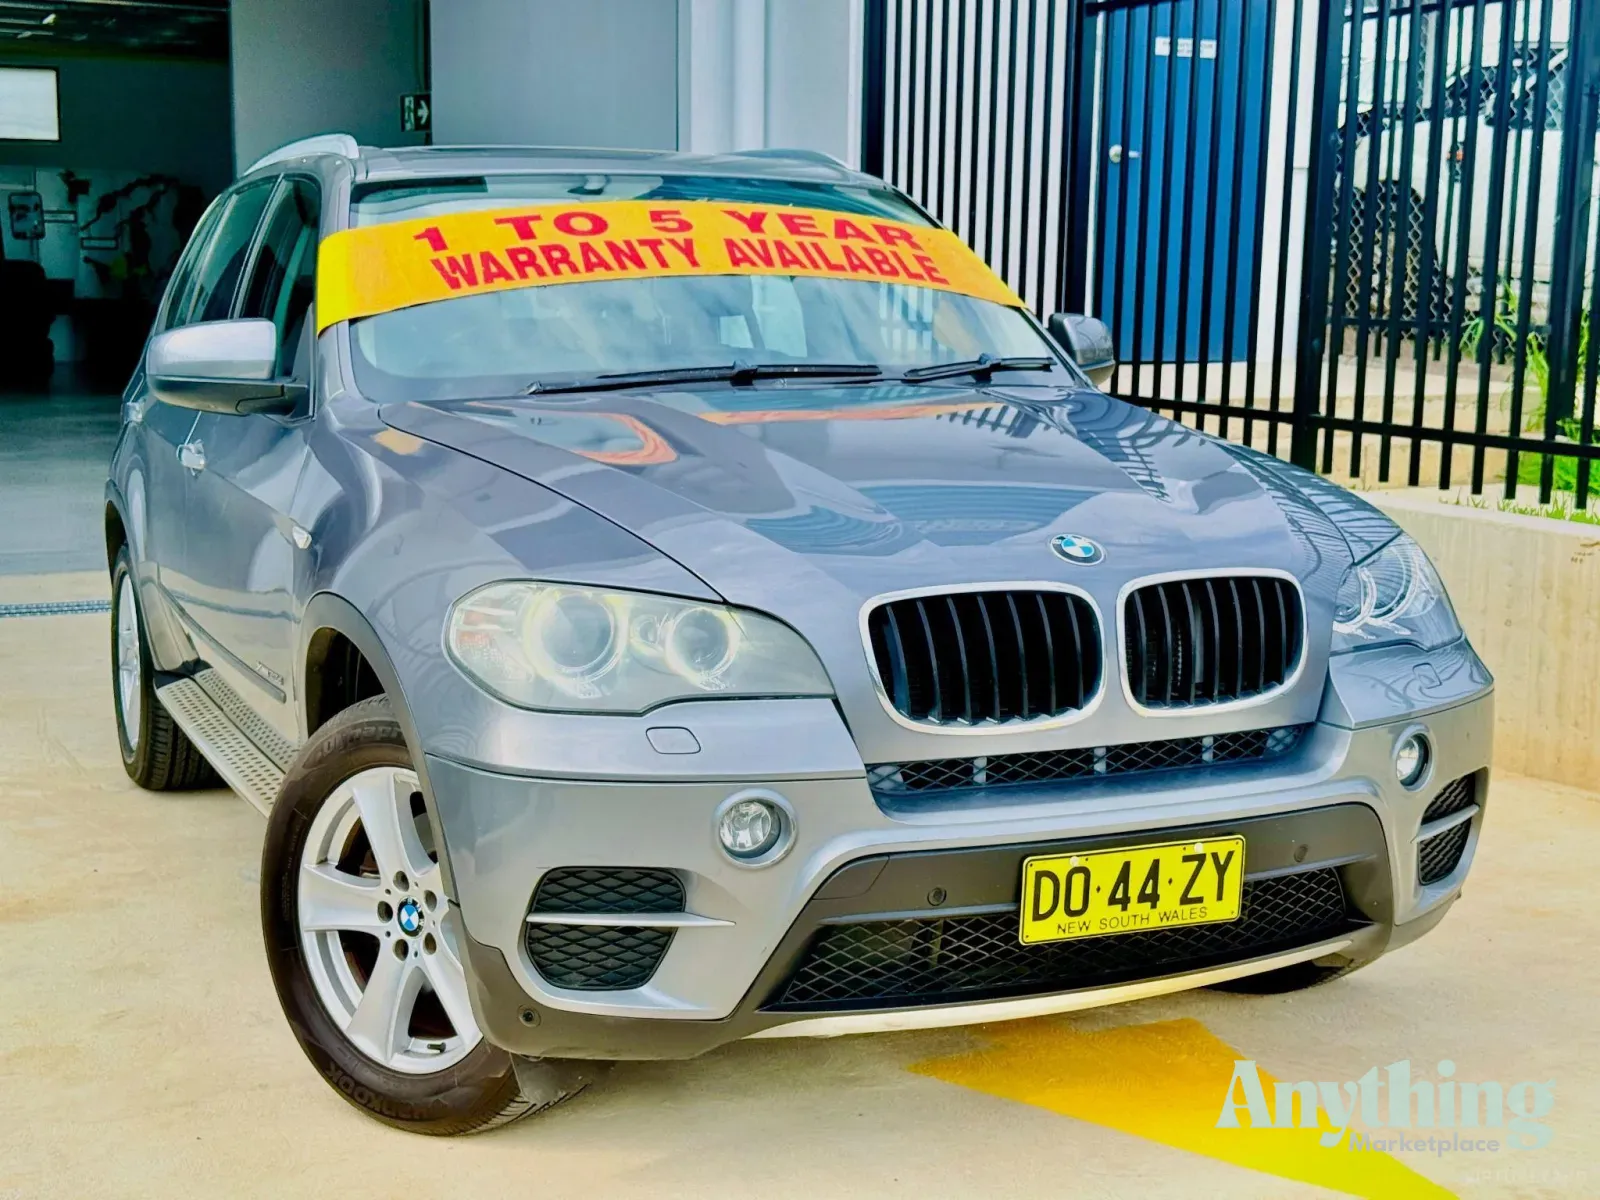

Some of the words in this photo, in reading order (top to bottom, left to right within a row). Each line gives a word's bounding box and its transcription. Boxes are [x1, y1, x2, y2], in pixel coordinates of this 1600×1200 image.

[413, 226, 448, 252] 1
[494, 211, 609, 241] TO
[648, 210, 693, 233] 5
[720, 210, 925, 252] YEAR
[430, 238, 701, 290] WARRANTY
[723, 238, 950, 286] AVAILABLE
[1056, 920, 1091, 935] NEW
[1099, 912, 1150, 930] SOUTH
[1158, 906, 1208, 924] WALES
